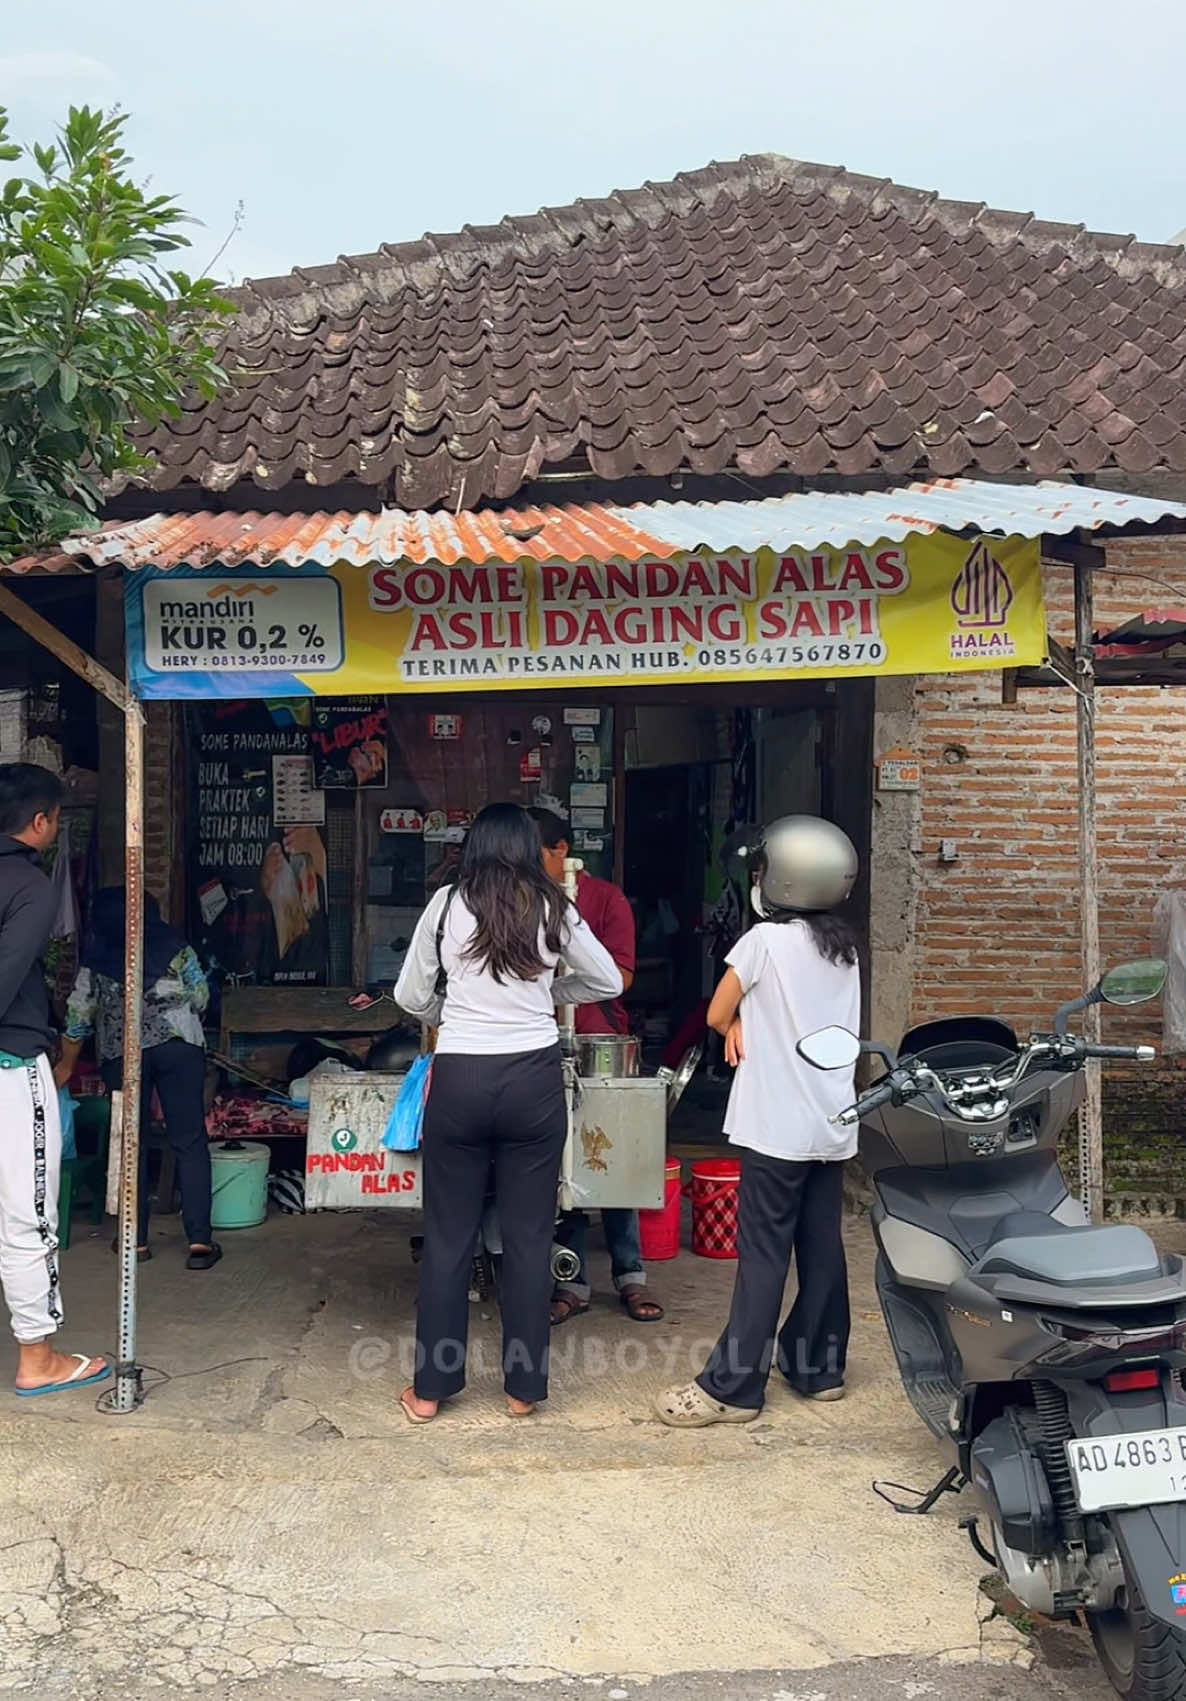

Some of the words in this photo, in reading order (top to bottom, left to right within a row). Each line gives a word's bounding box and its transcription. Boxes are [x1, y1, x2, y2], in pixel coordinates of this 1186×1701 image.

[372, 567, 523, 606] SOME
[540, 558, 751, 600] PANDAN
[773, 551, 905, 593] ALAS
[160, 596, 255, 618] mandiri
[411, 610, 524, 651] ASLI
[544, 603, 741, 647] DAGING
[760, 599, 873, 640] SAPI
[161, 625, 228, 650] KUR
[237, 624, 288, 654] 0,2
[298, 624, 325, 648] %
[951, 632, 1014, 649] HALAL
[162, 656, 198, 666] HERY
[211, 654, 326, 666] 0813-9300-7849
[403, 657, 498, 677] TERIMA
[508, 653, 621, 673] PESANAN
[631, 651, 689, 669] HUB.
[699, 642, 882, 667] 085647567870
[951, 648, 1015, 657] INDONESIA
[201, 734, 229, 750] SOME
[233, 733, 308, 750] PANDANALAS
[198, 762, 229, 786] BUKA
[199, 789, 250, 812] PRAKTEK
[199, 816, 238, 839] SETIAP
[241, 815, 269, 839] HARI
[199, 844, 224, 866] JAM
[228, 843, 263, 866] 08:00
[308, 1152, 385, 1173] PANDAN
[361, 1171, 416, 1194] ALAS
[1077, 1444, 1108, 1472] AD
[1115, 1437, 1173, 1468] 4863
